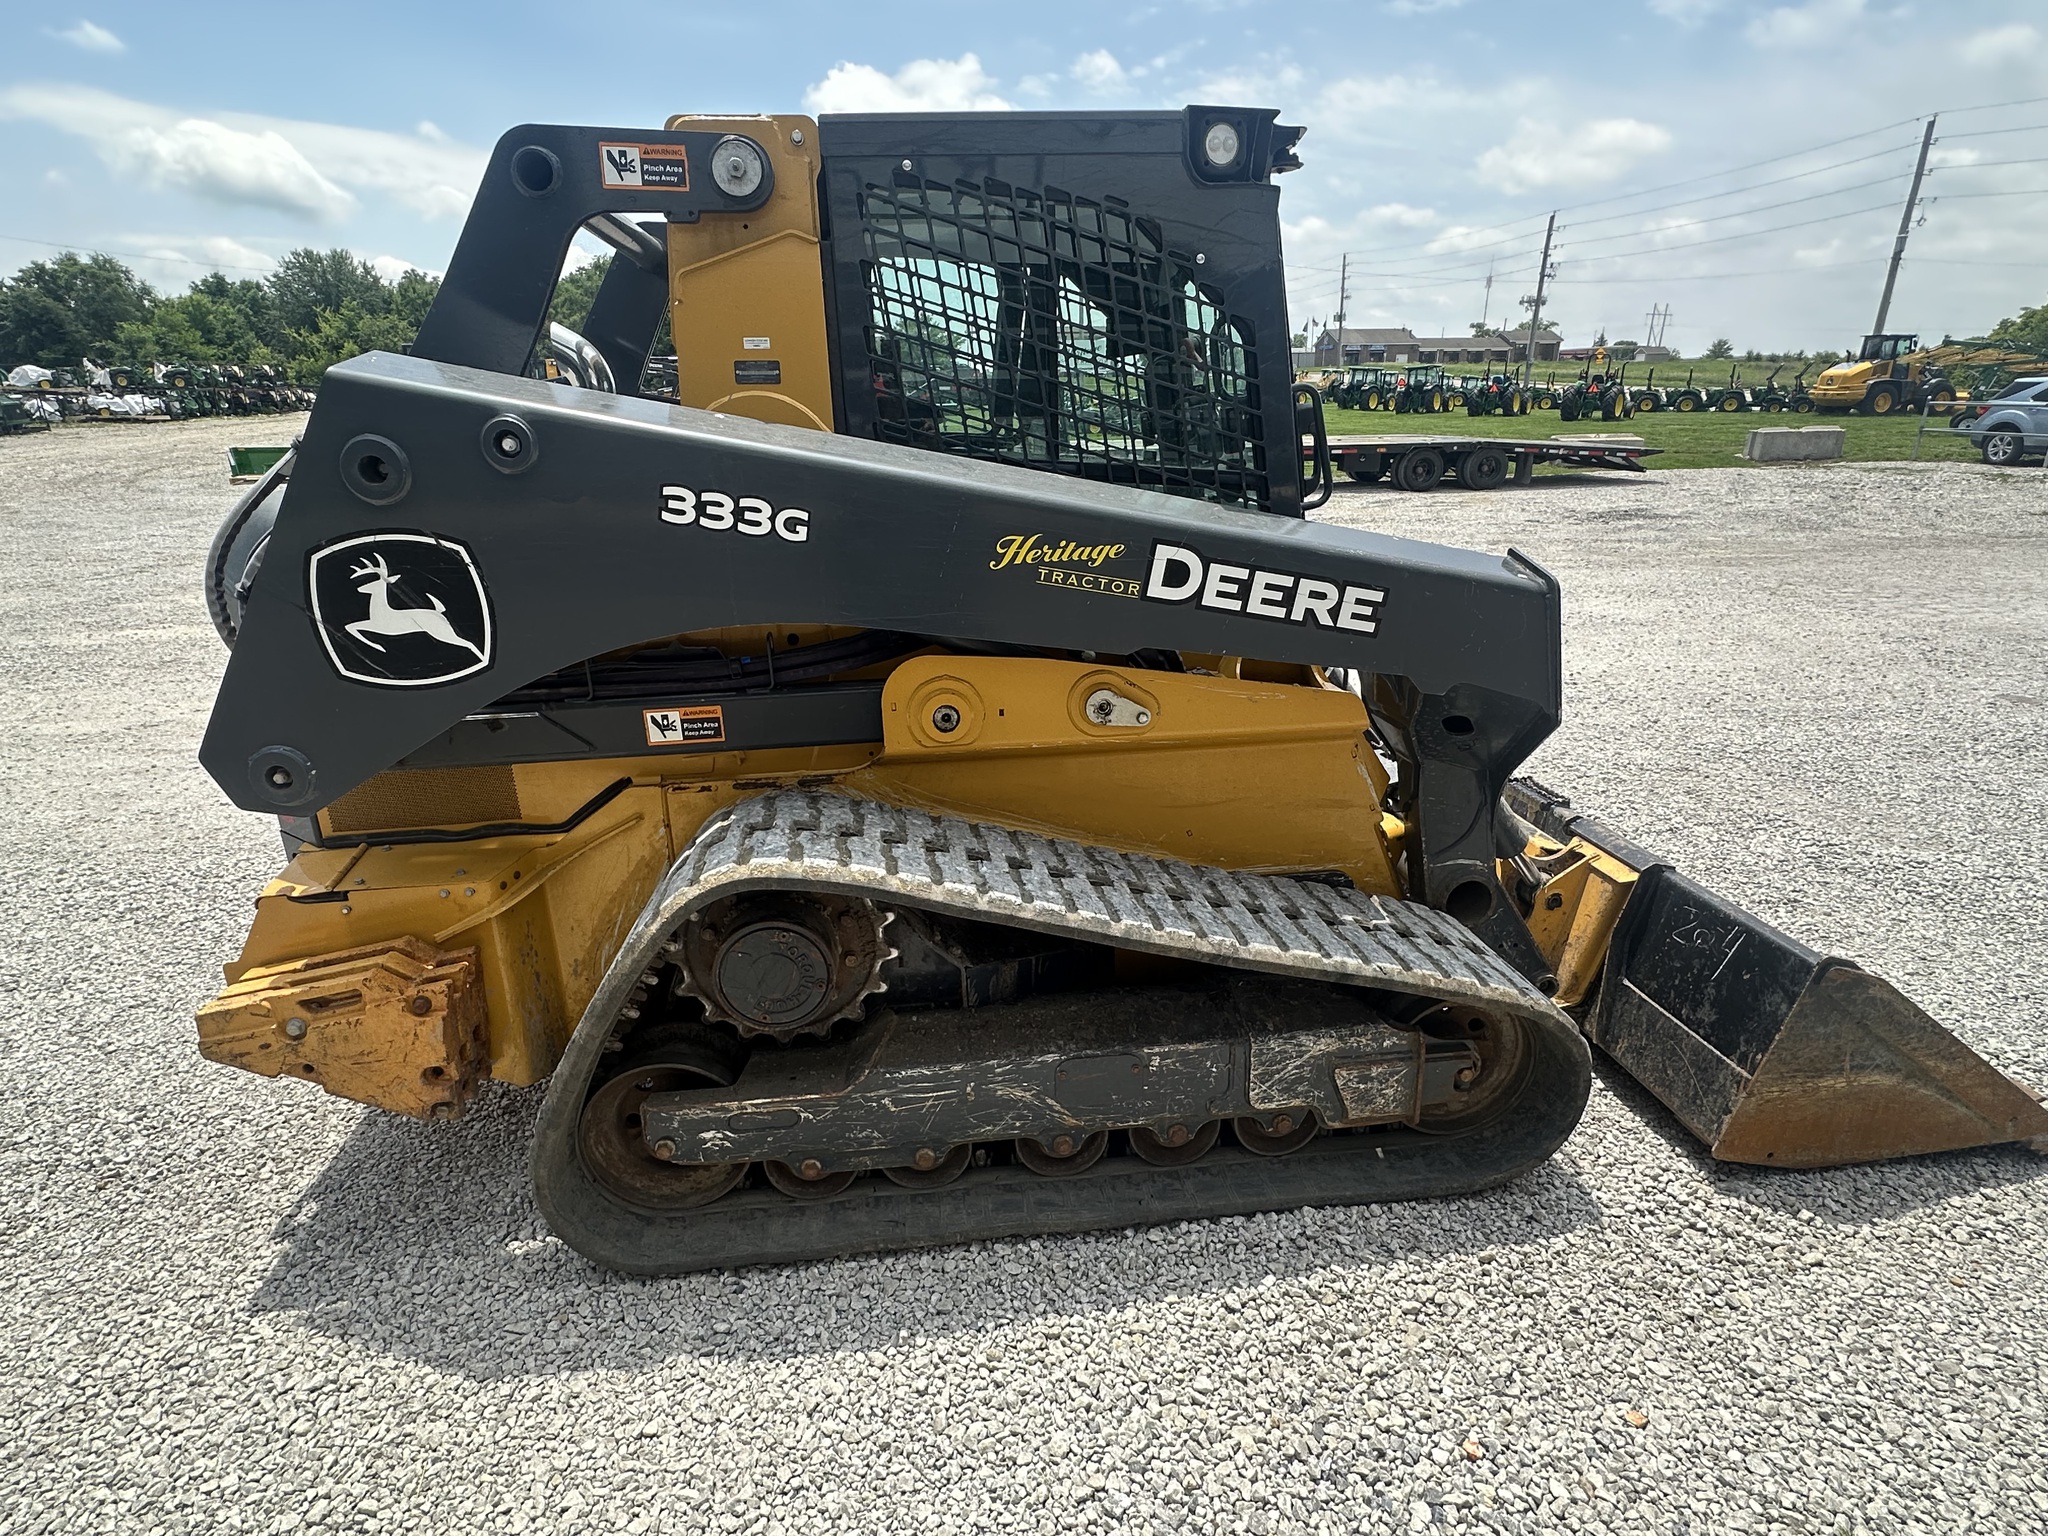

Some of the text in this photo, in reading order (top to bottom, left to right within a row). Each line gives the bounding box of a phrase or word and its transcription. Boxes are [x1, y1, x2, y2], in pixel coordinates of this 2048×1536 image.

[650, 148, 682, 156] WARNING
[643, 164, 683, 173] Pinch Area
[644, 174, 660, 182] Keep
[661, 486, 809, 542] 333G
[990, 533, 1127, 570] Heritage
[1038, 569, 1140, 596] TRACTOR
[1146, 543, 1384, 633] DEERE
